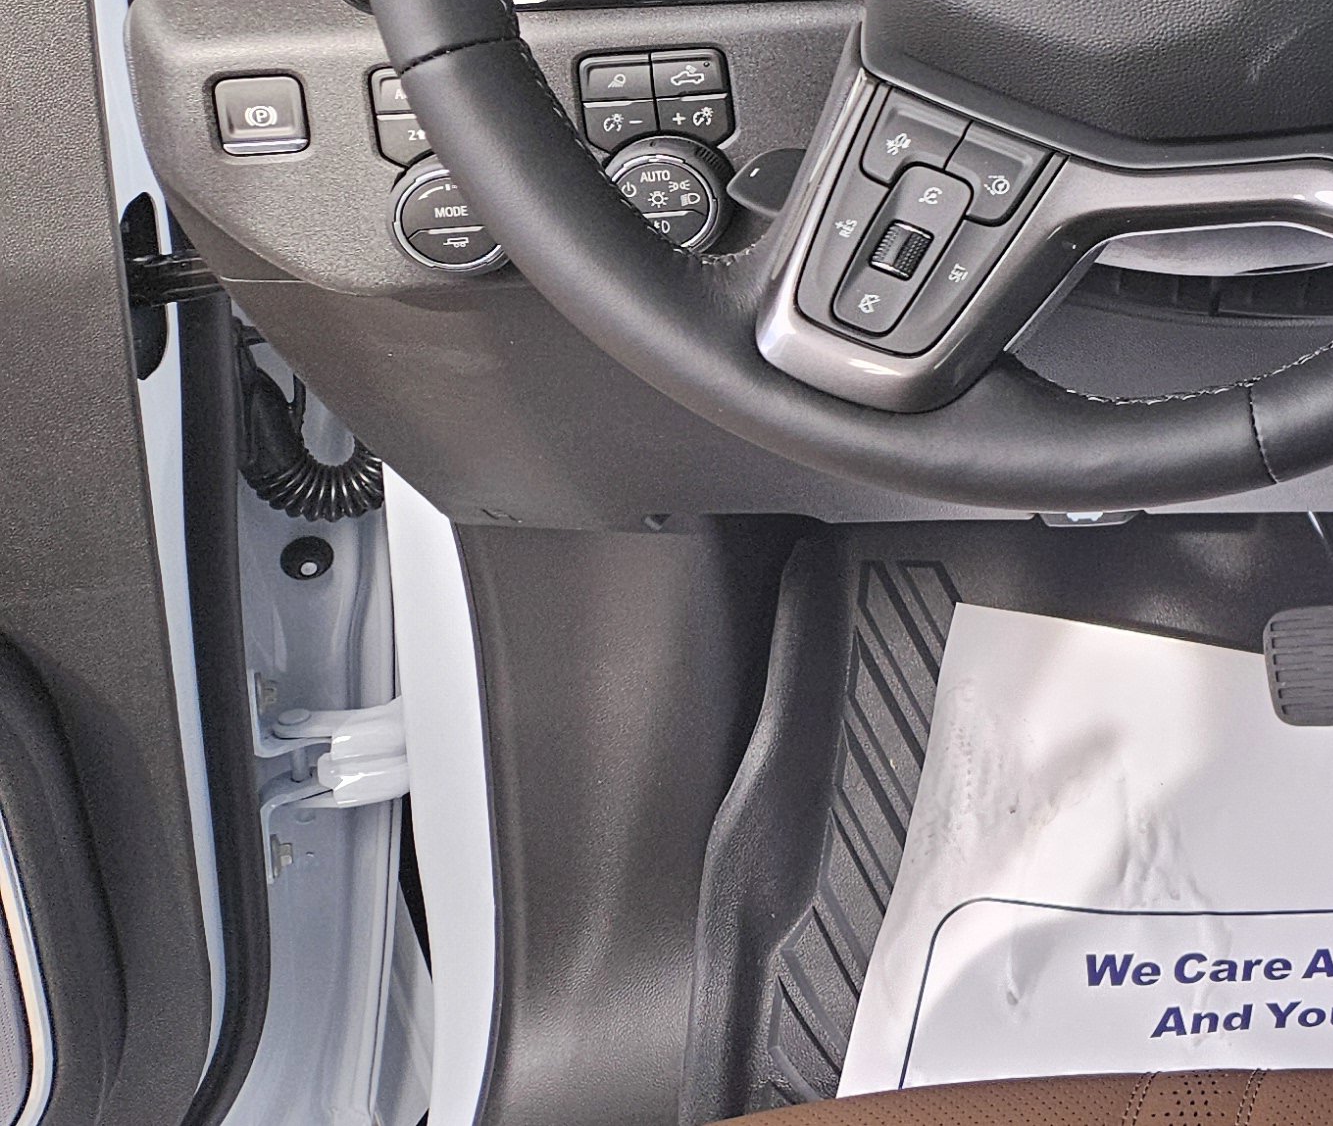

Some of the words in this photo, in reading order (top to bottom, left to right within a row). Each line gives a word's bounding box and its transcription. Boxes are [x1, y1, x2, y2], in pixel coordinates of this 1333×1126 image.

[640, 170, 671, 183] AUTO
[434, 205, 469, 218] MODE
[839, 219, 857, 238] RES
[948, 263, 968, 283] SET
[1085, 952, 1162, 987] We
[1173, 951, 1293, 985] Care
[1150, 1003, 1254, 1039] And
